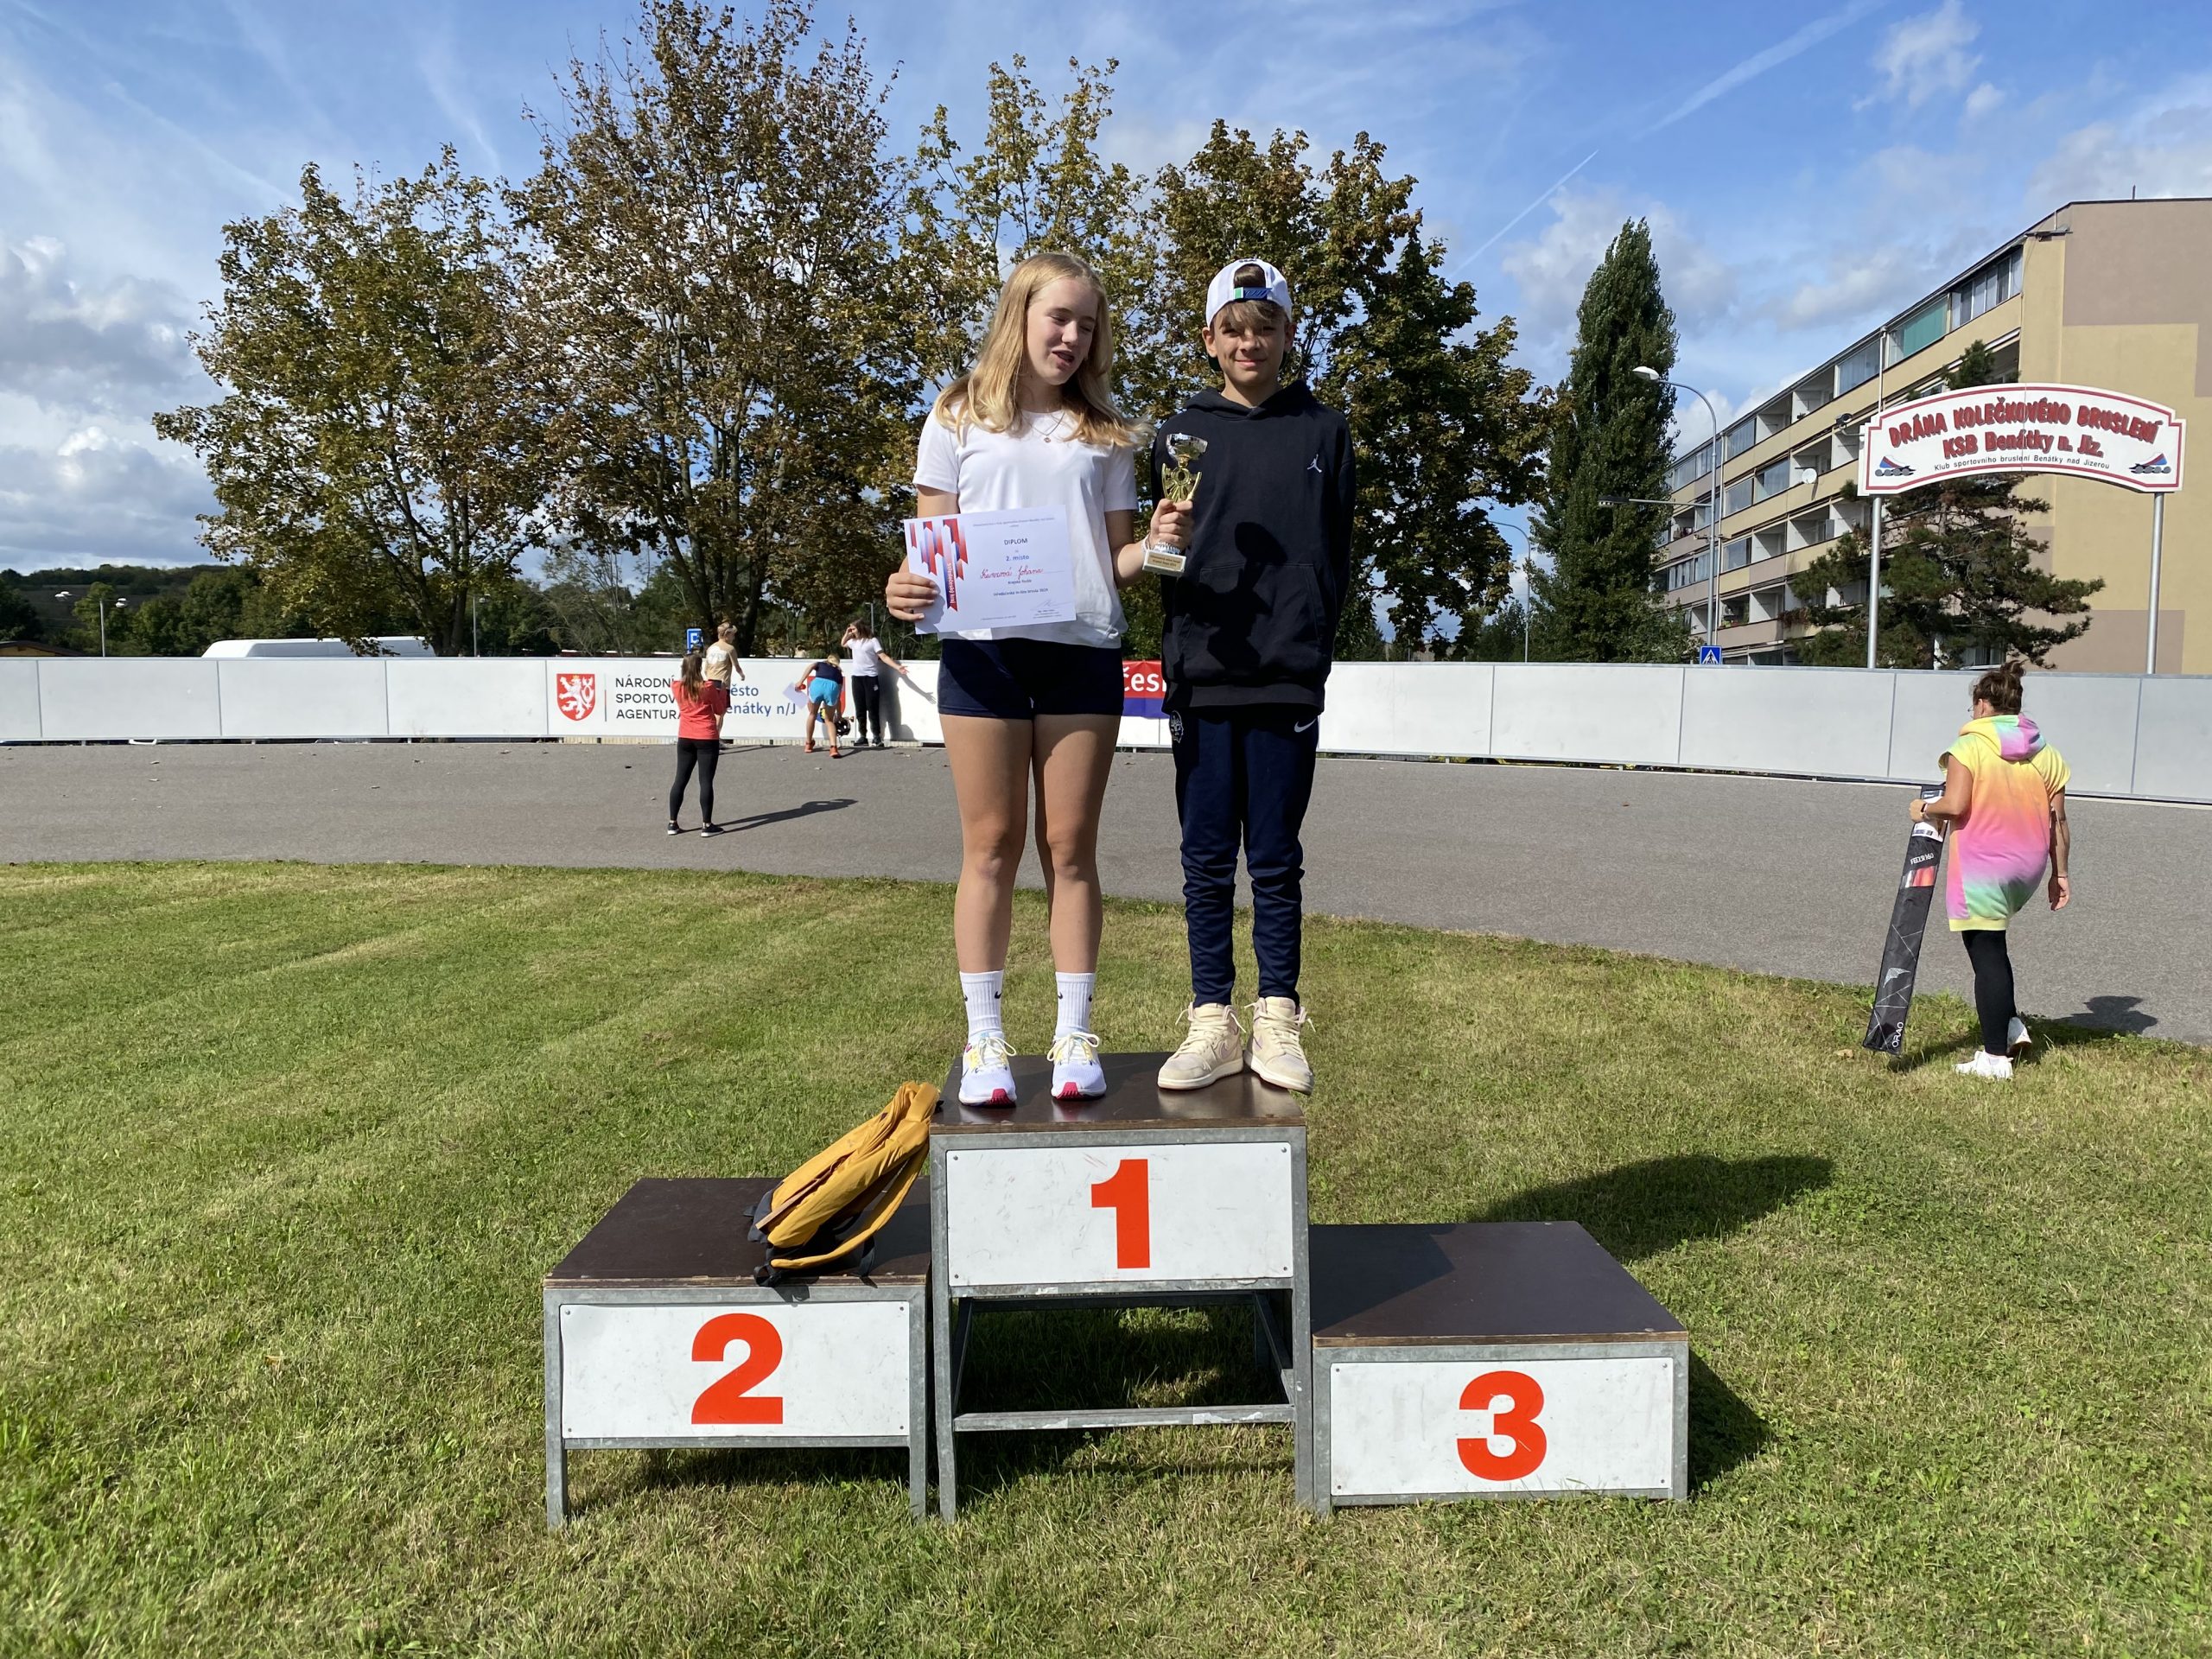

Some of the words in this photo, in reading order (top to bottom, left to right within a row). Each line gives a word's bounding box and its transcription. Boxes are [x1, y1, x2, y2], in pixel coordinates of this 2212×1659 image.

[1954, 397, 2071, 429] KOLEČKOVÉHO
[2077, 405, 2163, 444] BRUSLENÍ
[1942, 434, 1978, 460] KSB
[1985, 429, 2054, 454] Benátky
[1934, 461, 1949, 471] Klub
[2033, 454, 2063, 464] Benátky
[2067, 456, 2080, 465] nad
[2083, 459, 2110, 469] Jizerou
[615, 693, 676, 704] SPORTOV
[730, 683, 759, 696] ěsto
[727, 702, 772, 716] enátky
[1091, 1160, 1149, 1268] 1
[692, 1313, 783, 1424] 2
[1458, 1371, 1546, 1480] 3
